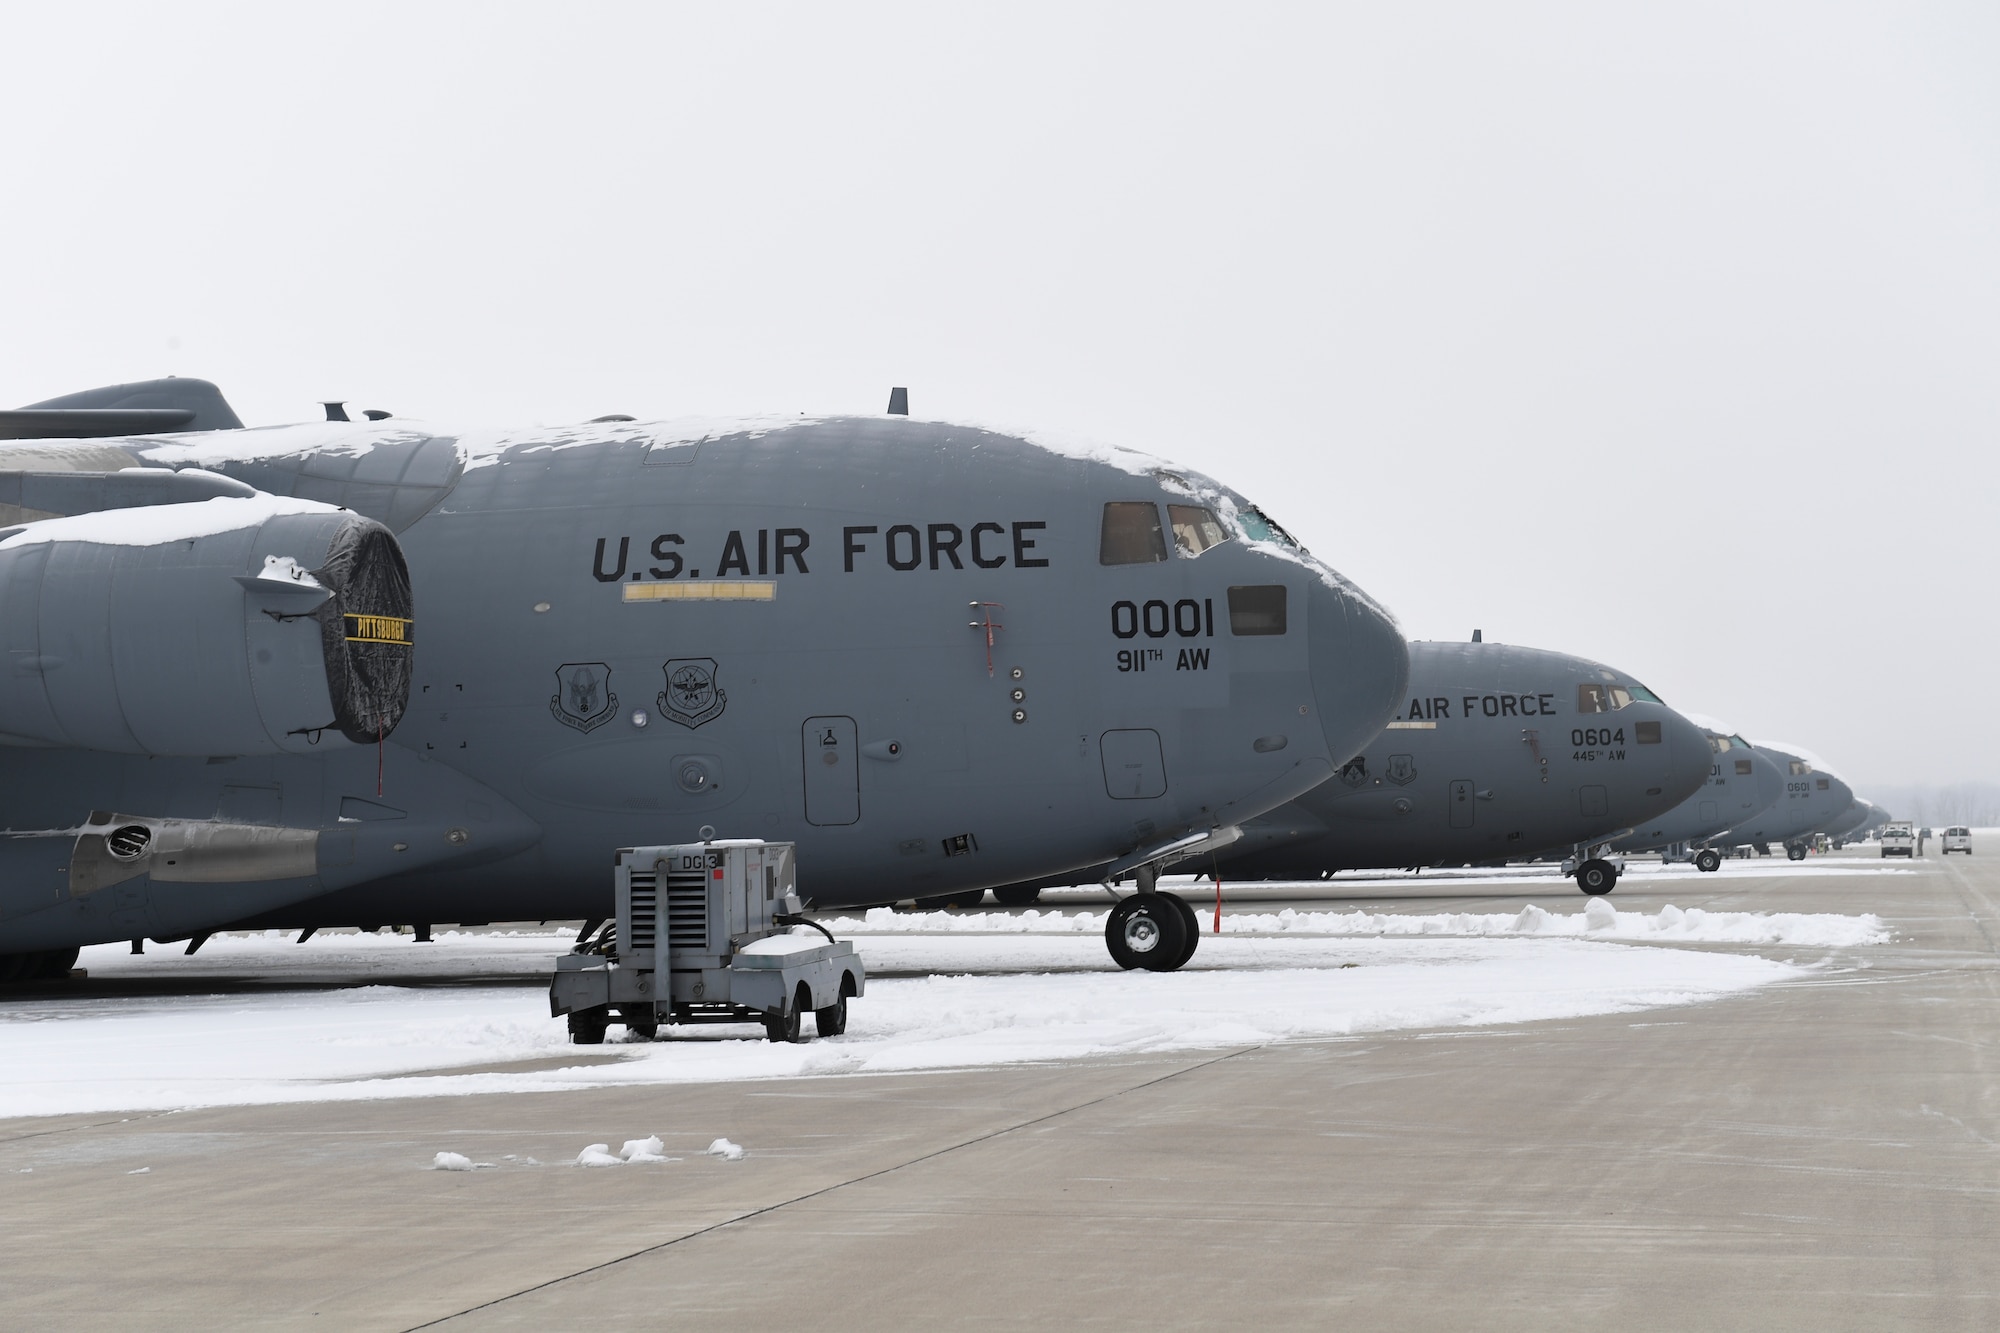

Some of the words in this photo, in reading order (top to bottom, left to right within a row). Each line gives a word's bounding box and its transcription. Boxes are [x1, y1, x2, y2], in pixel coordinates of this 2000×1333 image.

[592, 533, 700, 583] U.S.
[716, 527, 810, 577] AIR
[843, 521, 1049, 573] FORCE
[357, 617, 405, 641] PITTSBURGH
[1111, 598, 1214, 639] 0001
[1117, 649, 1163, 672] 911TH
[1176, 648, 1210, 671] AW
[1408, 697, 1450, 720] AIR
[1462, 693, 1557, 718] FORCE
[1571, 727, 1625, 747] 0604
[1572, 750, 1604, 762] 445TH
[1608, 749, 1626, 761] AW
[1787, 781, 1810, 792] 0601
